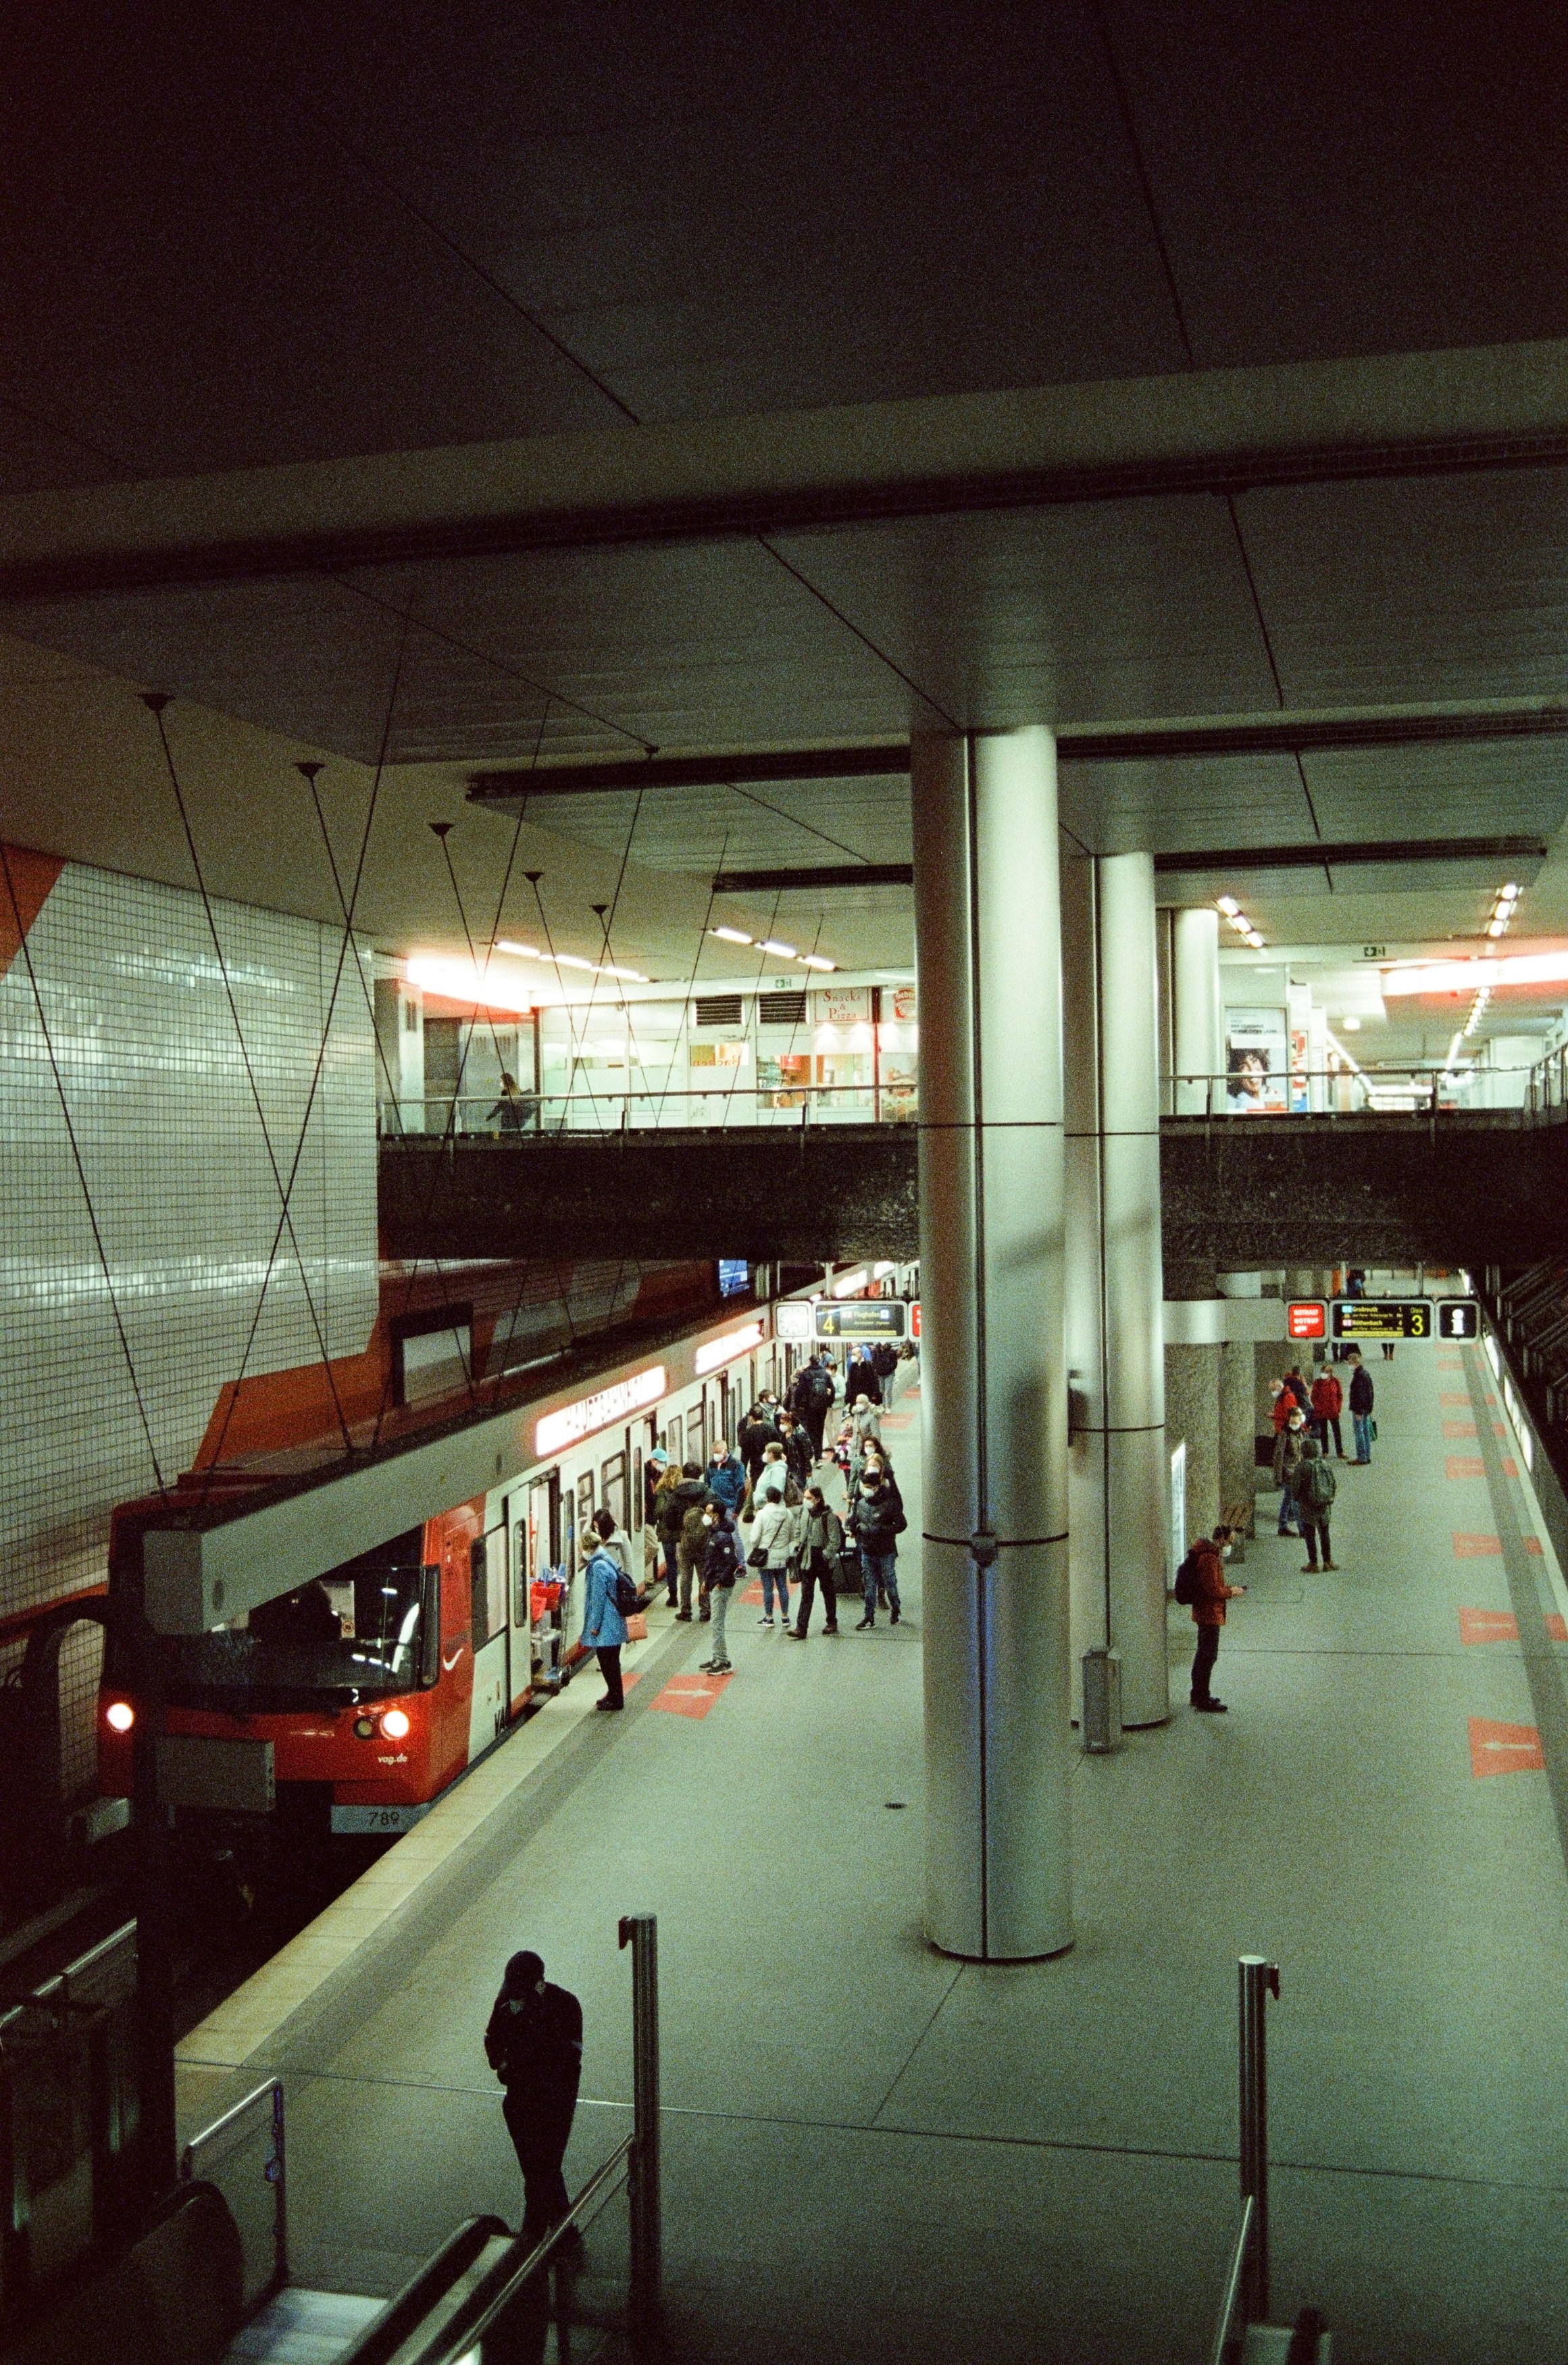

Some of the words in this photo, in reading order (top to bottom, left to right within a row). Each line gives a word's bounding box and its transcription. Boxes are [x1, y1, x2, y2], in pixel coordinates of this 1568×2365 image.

[824, 990, 861, 1001] Snacks
[829, 1007, 856, 1019] Pizza
[823, 1315, 834, 1335] 4
[1411, 1314, 1424, 1335] 3
[378, 1753, 407, 1765] vag.de
[368, 1812, 399, 1825] 789
